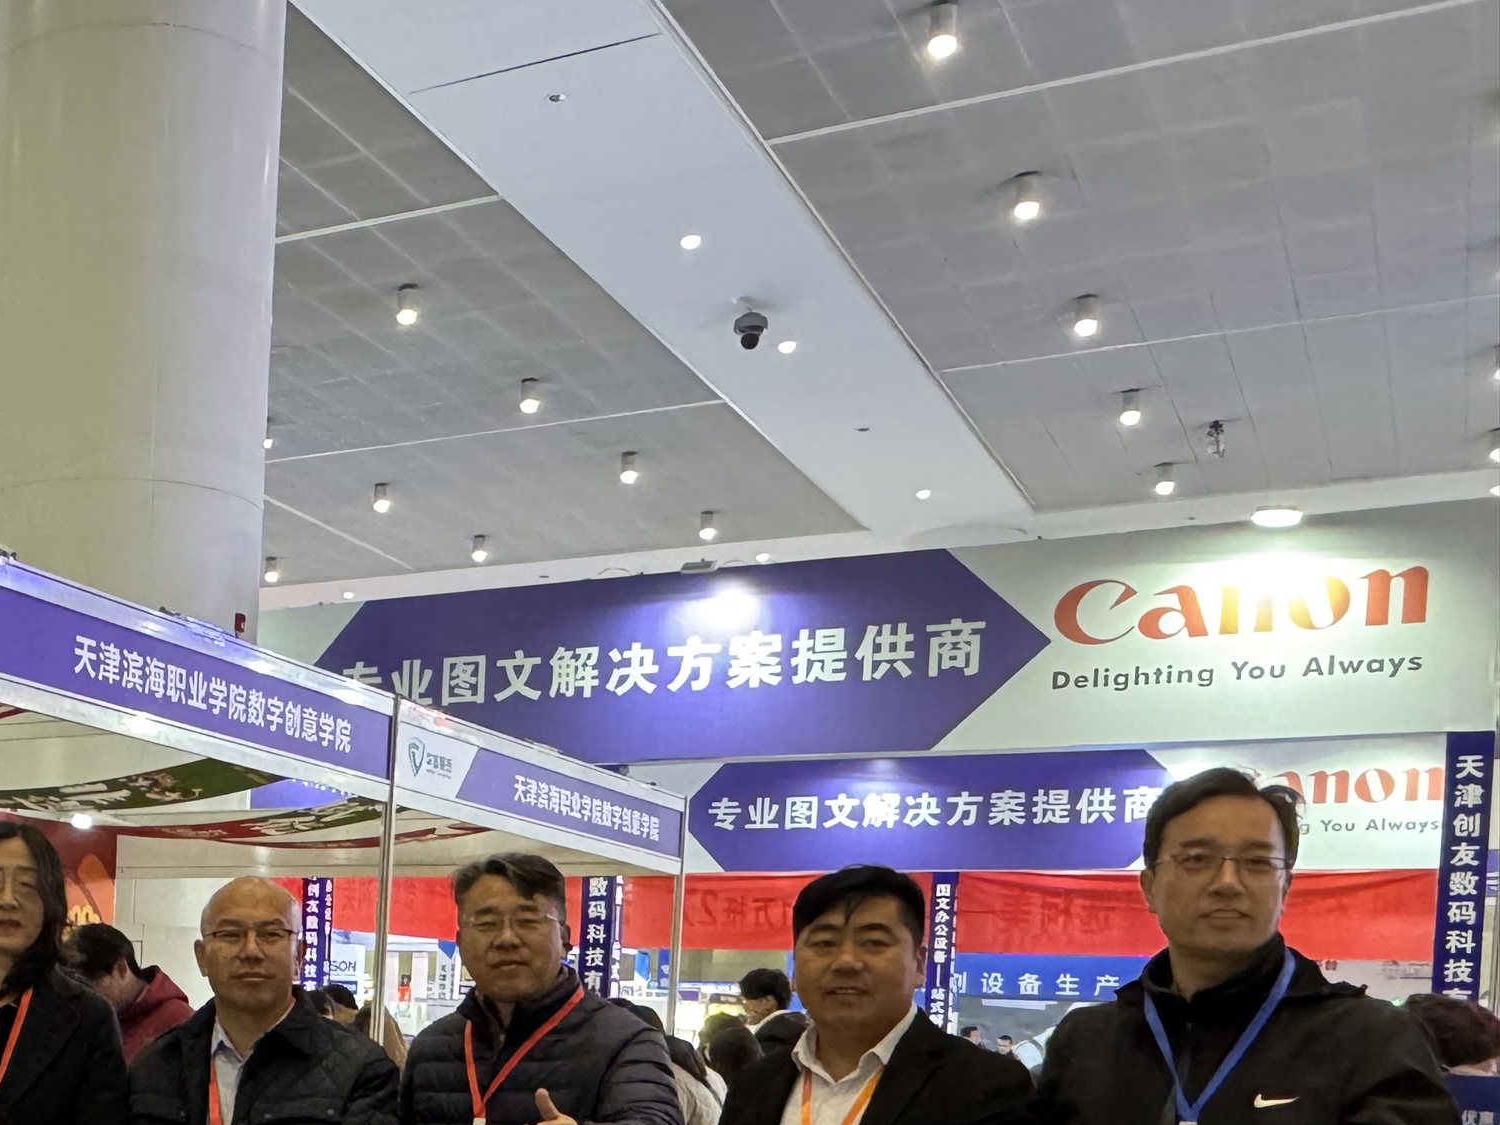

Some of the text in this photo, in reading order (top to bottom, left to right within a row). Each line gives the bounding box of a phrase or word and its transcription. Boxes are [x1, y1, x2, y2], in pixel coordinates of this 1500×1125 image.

[1053, 565, 1429, 645] Canon
[1051, 654, 1423, 691] Delighting You Always
[73, 634, 352, 754] 天津滨海职业学院数字创意学院
[1270, 767, 1444, 804] anon
[707, 785, 1164, 832] 专业图文解决方案提供商
[1320, 819, 1356, 832] You
[1365, 817, 1440, 834] Always
